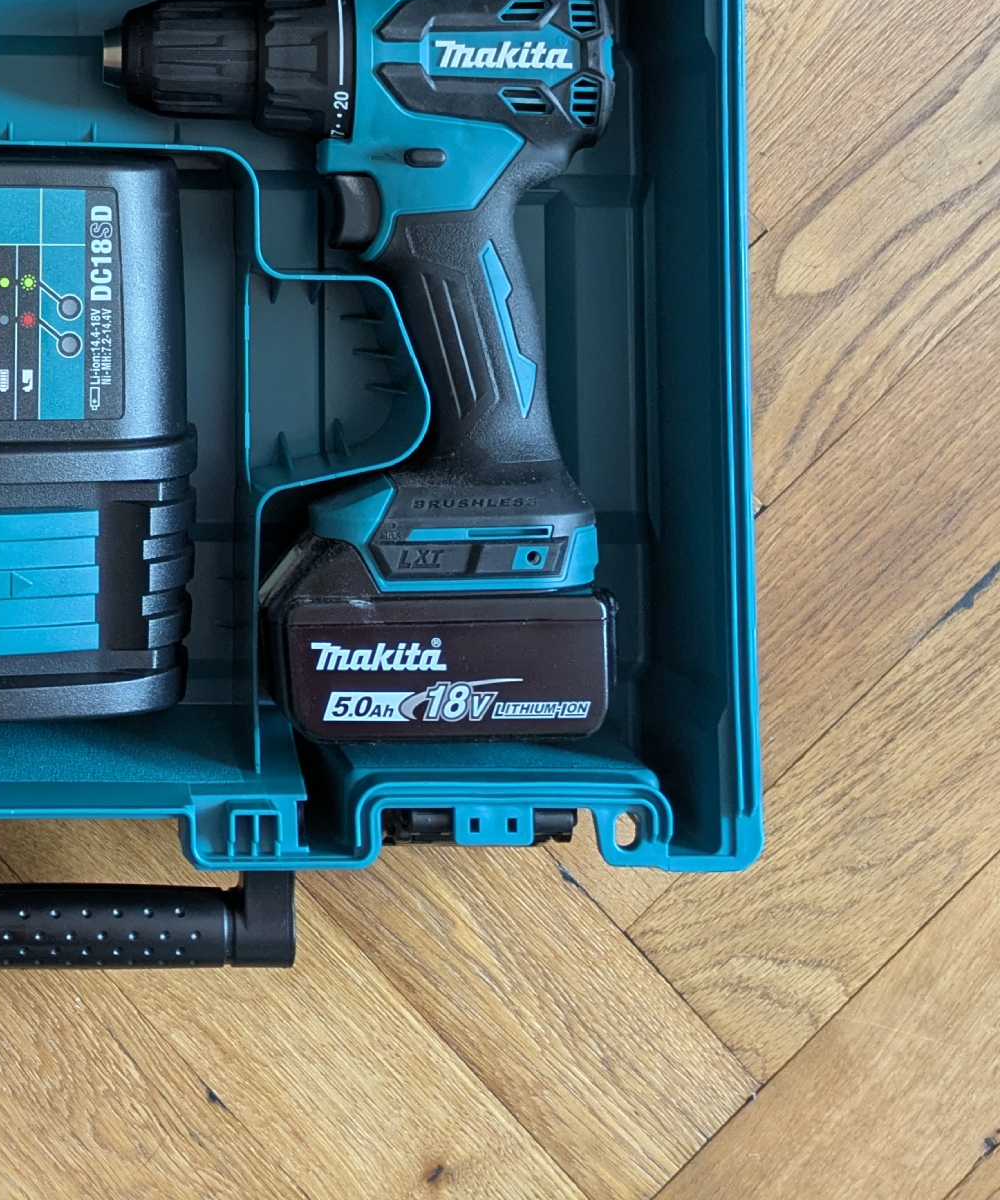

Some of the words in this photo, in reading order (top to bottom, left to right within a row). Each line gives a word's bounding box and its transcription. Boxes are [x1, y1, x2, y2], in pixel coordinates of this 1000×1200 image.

[333, 91, 350, 111] 20
[90, 205, 113, 301] DC18SD
[90, 308, 101, 385] Li-ion:14.4-18V
[101, 308, 112, 385] Ni-MH:7.2-14.4V
[411, 497, 537, 509] BRUSHLESS
[397, 549, 444, 569] LXT
[331, 696, 394, 719] 5.0Ah
[423, 681, 498, 722] 18V
[492, 701, 591, 720] LITHIUM-ION
